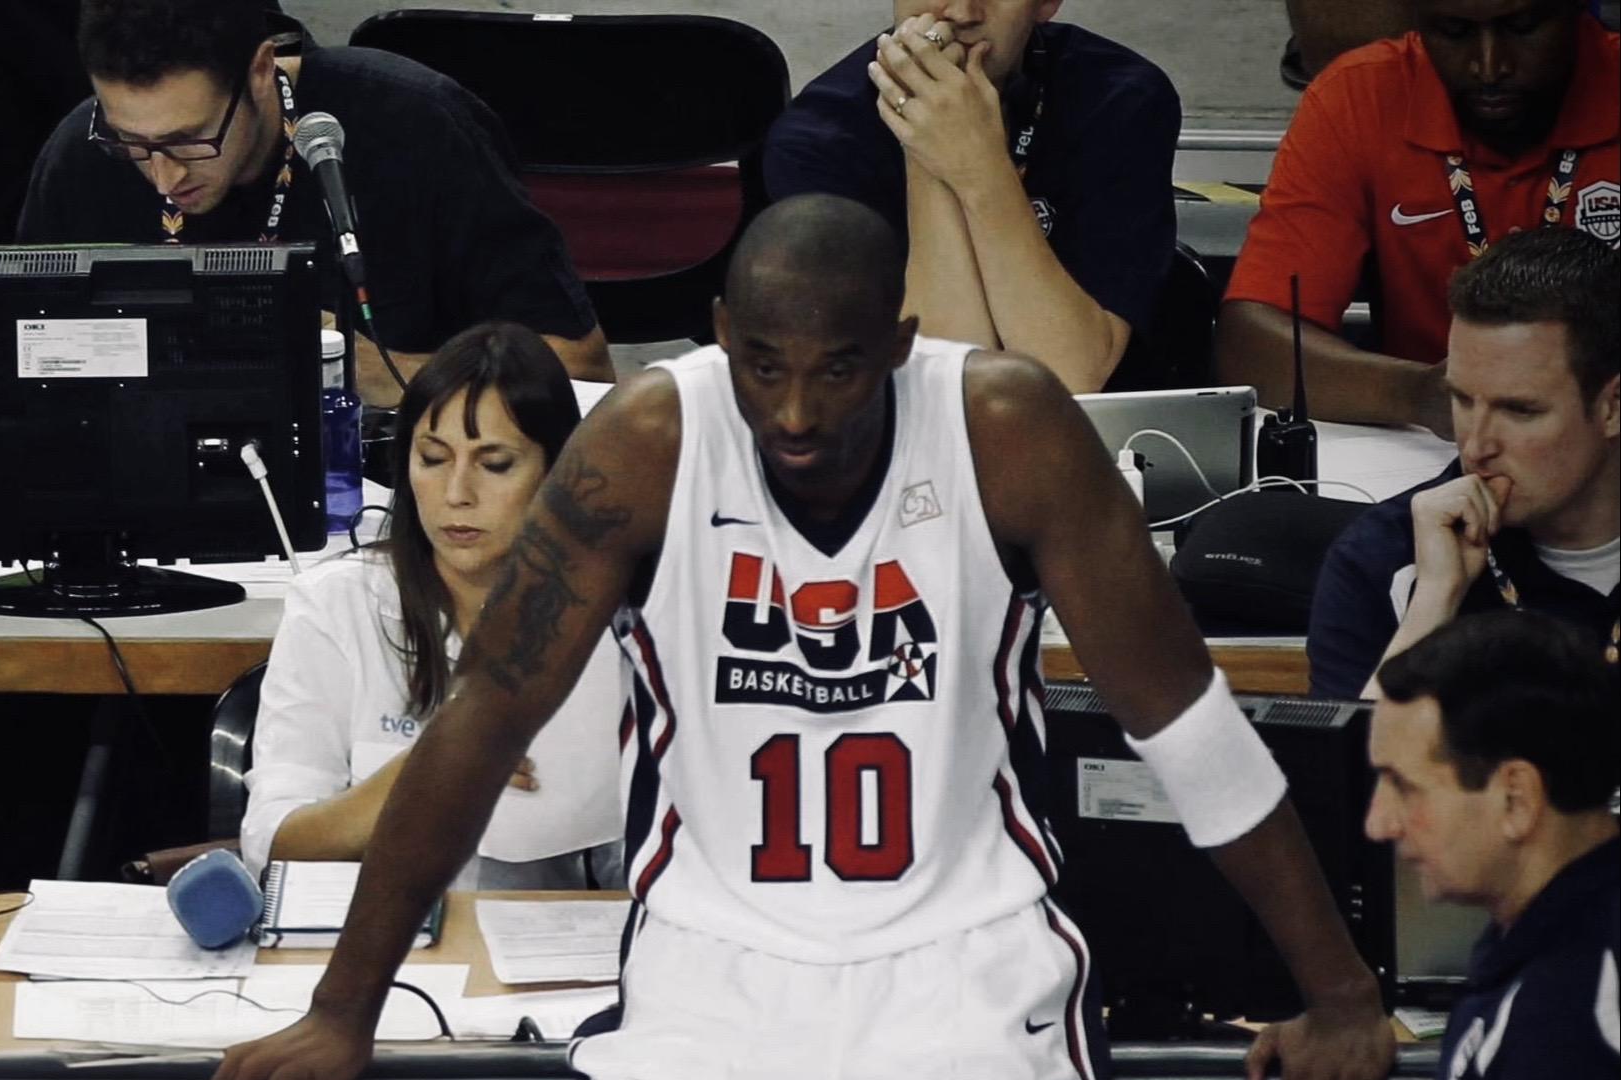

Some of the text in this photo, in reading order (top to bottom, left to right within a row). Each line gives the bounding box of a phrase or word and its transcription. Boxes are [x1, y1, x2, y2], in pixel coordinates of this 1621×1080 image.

[722, 552, 938, 671] USA
[729, 666, 874, 704] BASKETBALL
[380, 712, 415, 738] tve
[750, 732, 914, 882] 10
